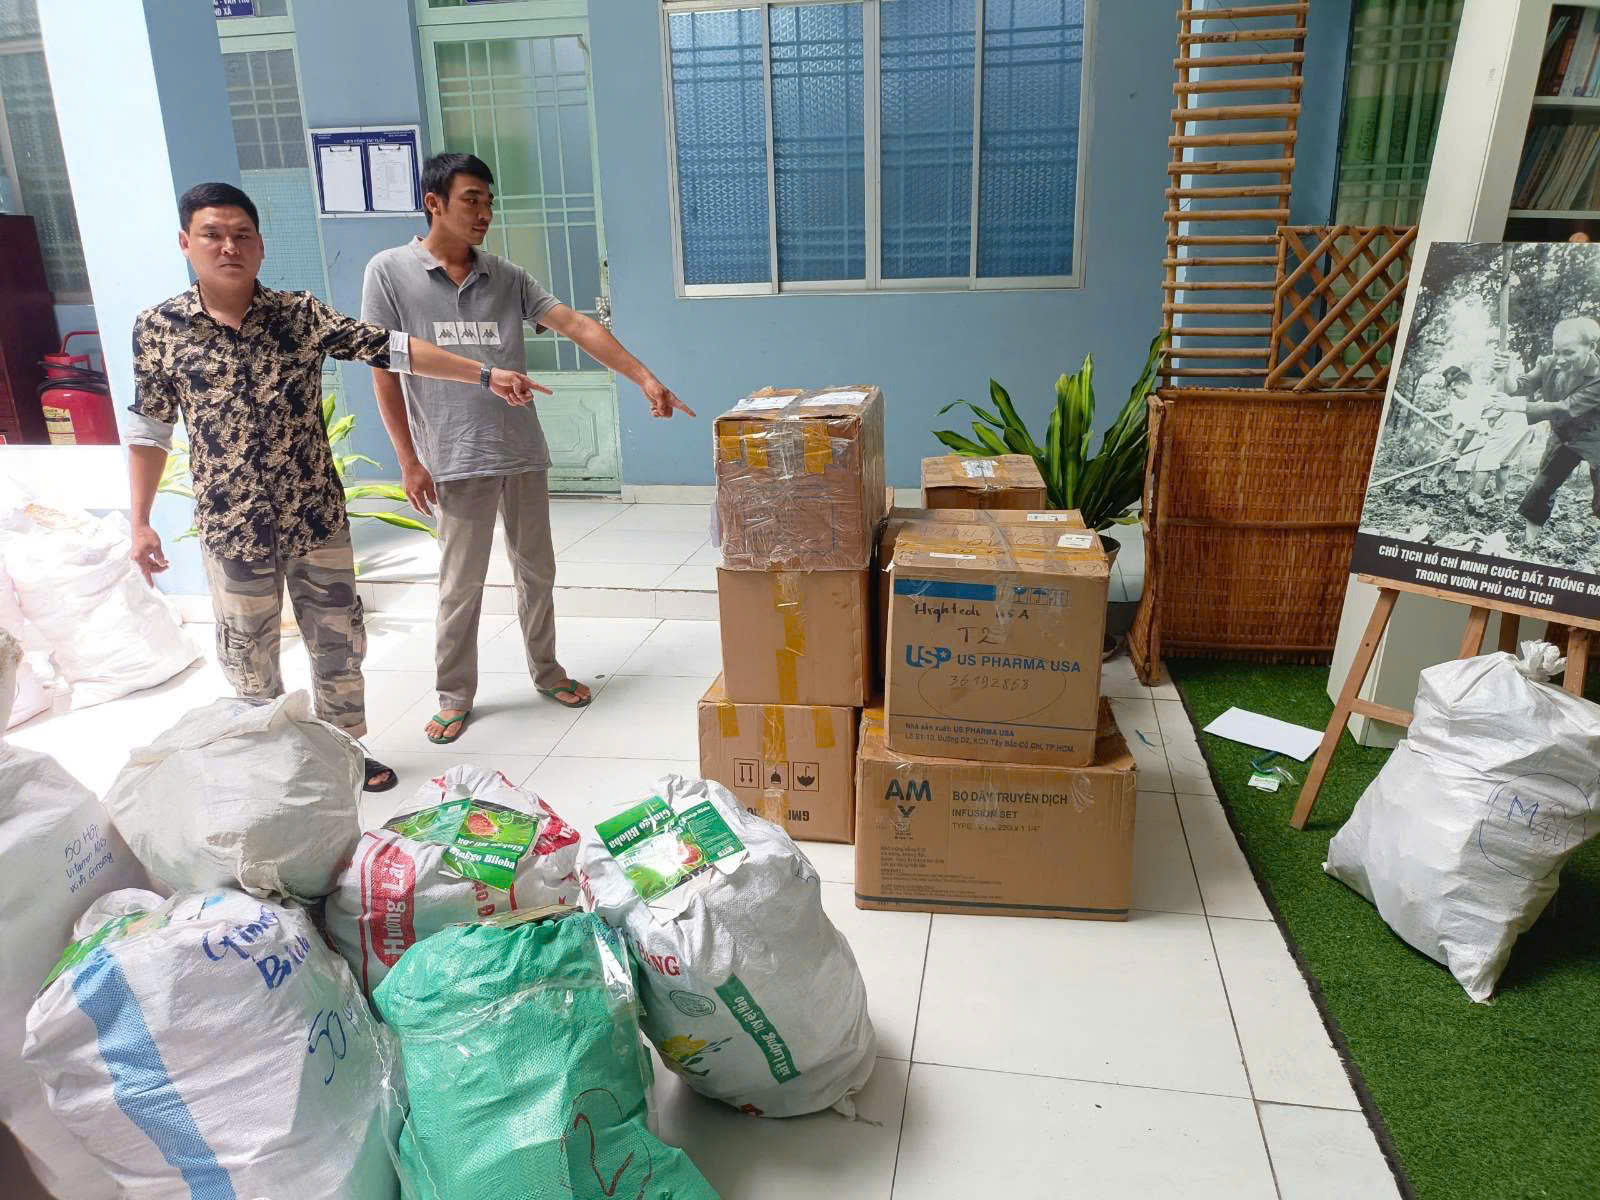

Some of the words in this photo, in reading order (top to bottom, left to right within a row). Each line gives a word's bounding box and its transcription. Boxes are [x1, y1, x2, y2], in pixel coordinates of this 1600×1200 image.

[1379, 544, 1399, 558] CHỦ
[1400, 548, 1423, 562] TỊCH
[1424, 551, 1439, 565] HỒ
[1440, 556, 1459, 569] CHÍ
[1460, 559, 1489, 575] MINH
[1490, 564, 1520, 580] CUỐC
[1521, 569, 1544, 587] ĐẤT,
[1415, 568, 1448, 585] TRONG
[1450, 575, 1478, 590] VƯỜN
[1479, 580, 1502, 595] PHỦ
[1504, 585, 1526, 600] CHỦ
[1529, 590, 1554, 605] TỊCH
[905, 644, 952, 669] USP
[957, 654, 977, 666] US
[982, 655, 1047, 671] PHARMA
[1050, 660, 1081, 673] USA
[965, 726, 998, 736] PHARMA
[1000, 729, 1015, 737] USA
[884, 779, 932, 801] AM
[1041, 794, 1068, 807] DỊCH
[608, 826, 641, 849] Biloba
[483, 853, 516, 870] Biloba
[383, 899, 407, 956] Hương
